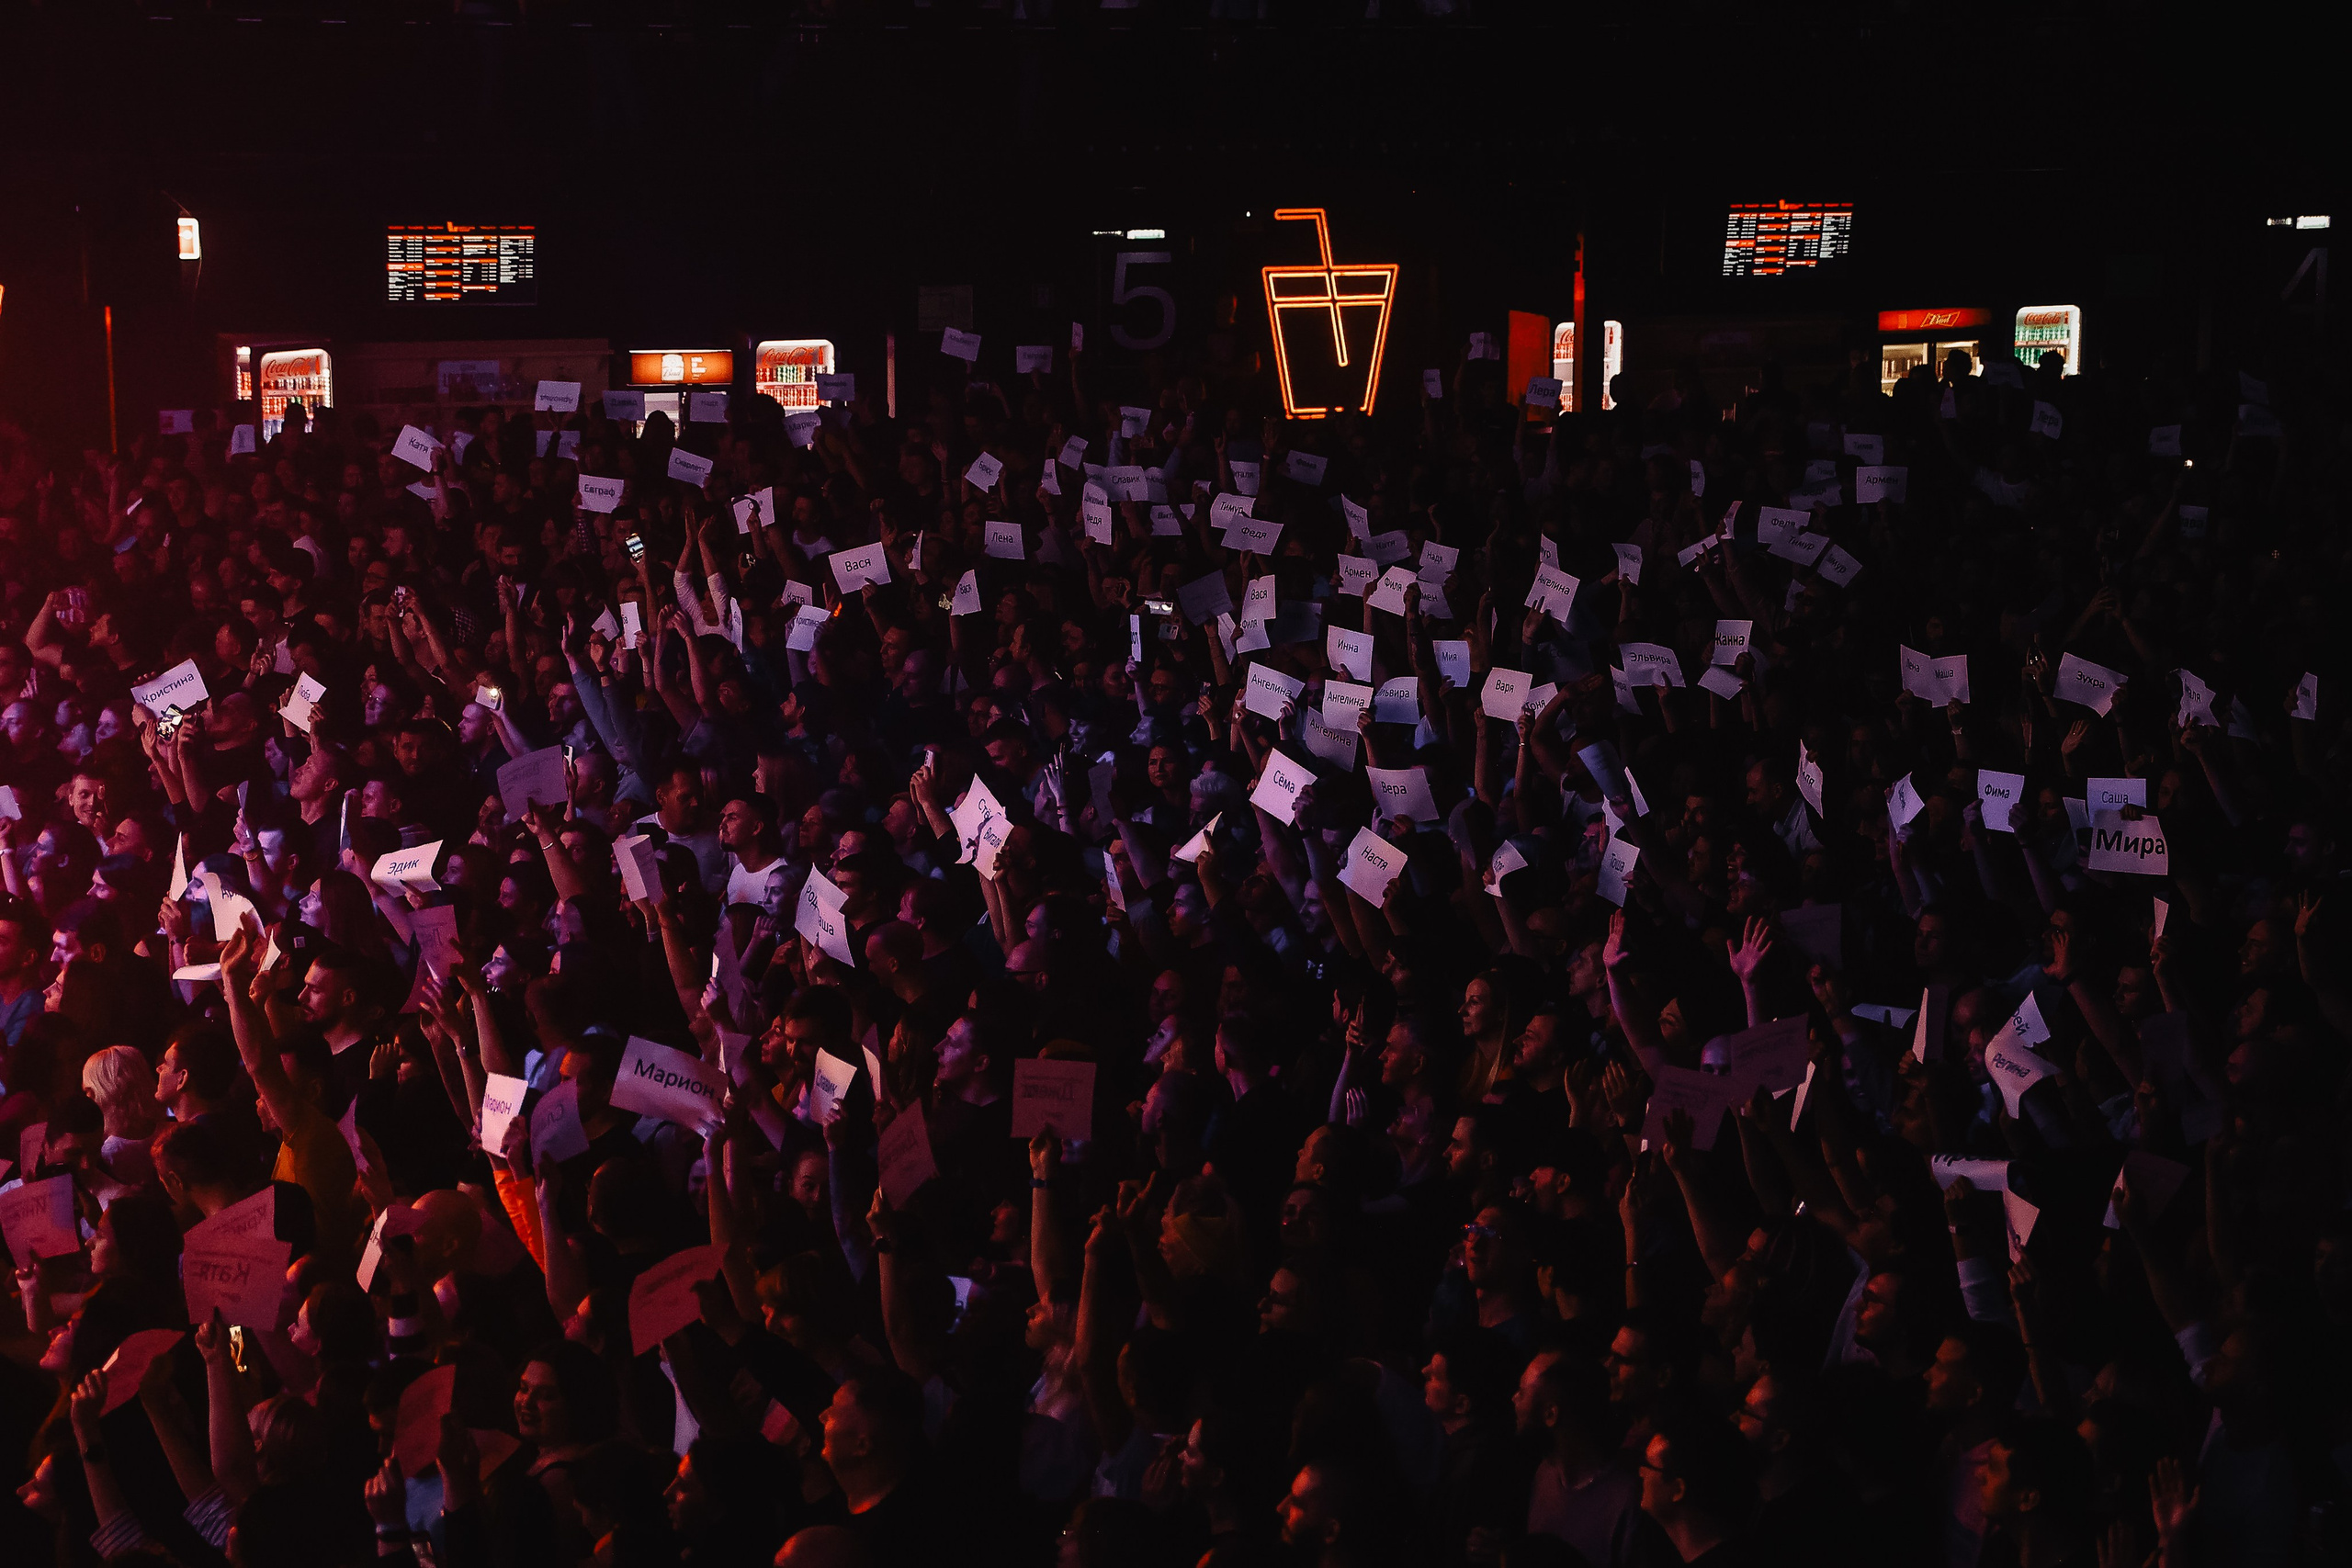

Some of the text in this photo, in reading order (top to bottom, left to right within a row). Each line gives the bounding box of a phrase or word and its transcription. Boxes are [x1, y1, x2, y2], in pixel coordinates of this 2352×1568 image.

[1110, 251, 1177, 350] 5
[762, 348, 814, 367] Coca-Cola
[266, 357, 313, 377] Coca-Cola
[1529, 384, 1555, 397] Лера
[410, 437, 430, 454] Катя
[1112, 474, 1140, 485] Славик
[1865, 475, 1899, 485] Армен
[584, 483, 616, 497] Евграф
[1220, 502, 1244, 515] Тимур
[991, 532, 1013, 544] Лена
[1241, 527, 1267, 539] Федя
[1788, 536, 1815, 550] Тимур
[845, 558, 872, 572] Вася
[1344, 567, 1372, 579] Армен
[1384, 577, 1402, 592] Филя
[1537, 574, 1570, 595] Ангелина
[1250, 588, 1268, 601] Вася
[1420, 592, 1438, 603] мен
[1338, 638, 1359, 653] Инна
[1714, 635, 1746, 647] Жанна
[1442, 651, 1457, 661] Мия
[1630, 651, 1671, 665] Эльвира
[1935, 669, 1953, 680] Маша
[2076, 671, 2105, 689] Зухра
[142, 672, 195, 705] Кристина
[1251, 674, 1293, 697] Ангелина
[1496, 679, 1514, 694] Варя
[1327, 691, 1364, 706] Ангелина
[1310, 718, 1351, 746] Ангелина
[1273, 770, 1295, 794] Сёма
[1381, 781, 1408, 796] Вера
[1984, 784, 2010, 799] Фима
[2101, 791, 2129, 804] Саша
[978, 798, 992, 821] Стё
[2096, 829, 2165, 859] Мира
[1361, 845, 1389, 871] Настя
[387, 860, 420, 875] Эдик
[819, 917, 834, 936] аша
[1994, 1053, 2030, 1077] Регина
[634, 1058, 715, 1099] Марион
